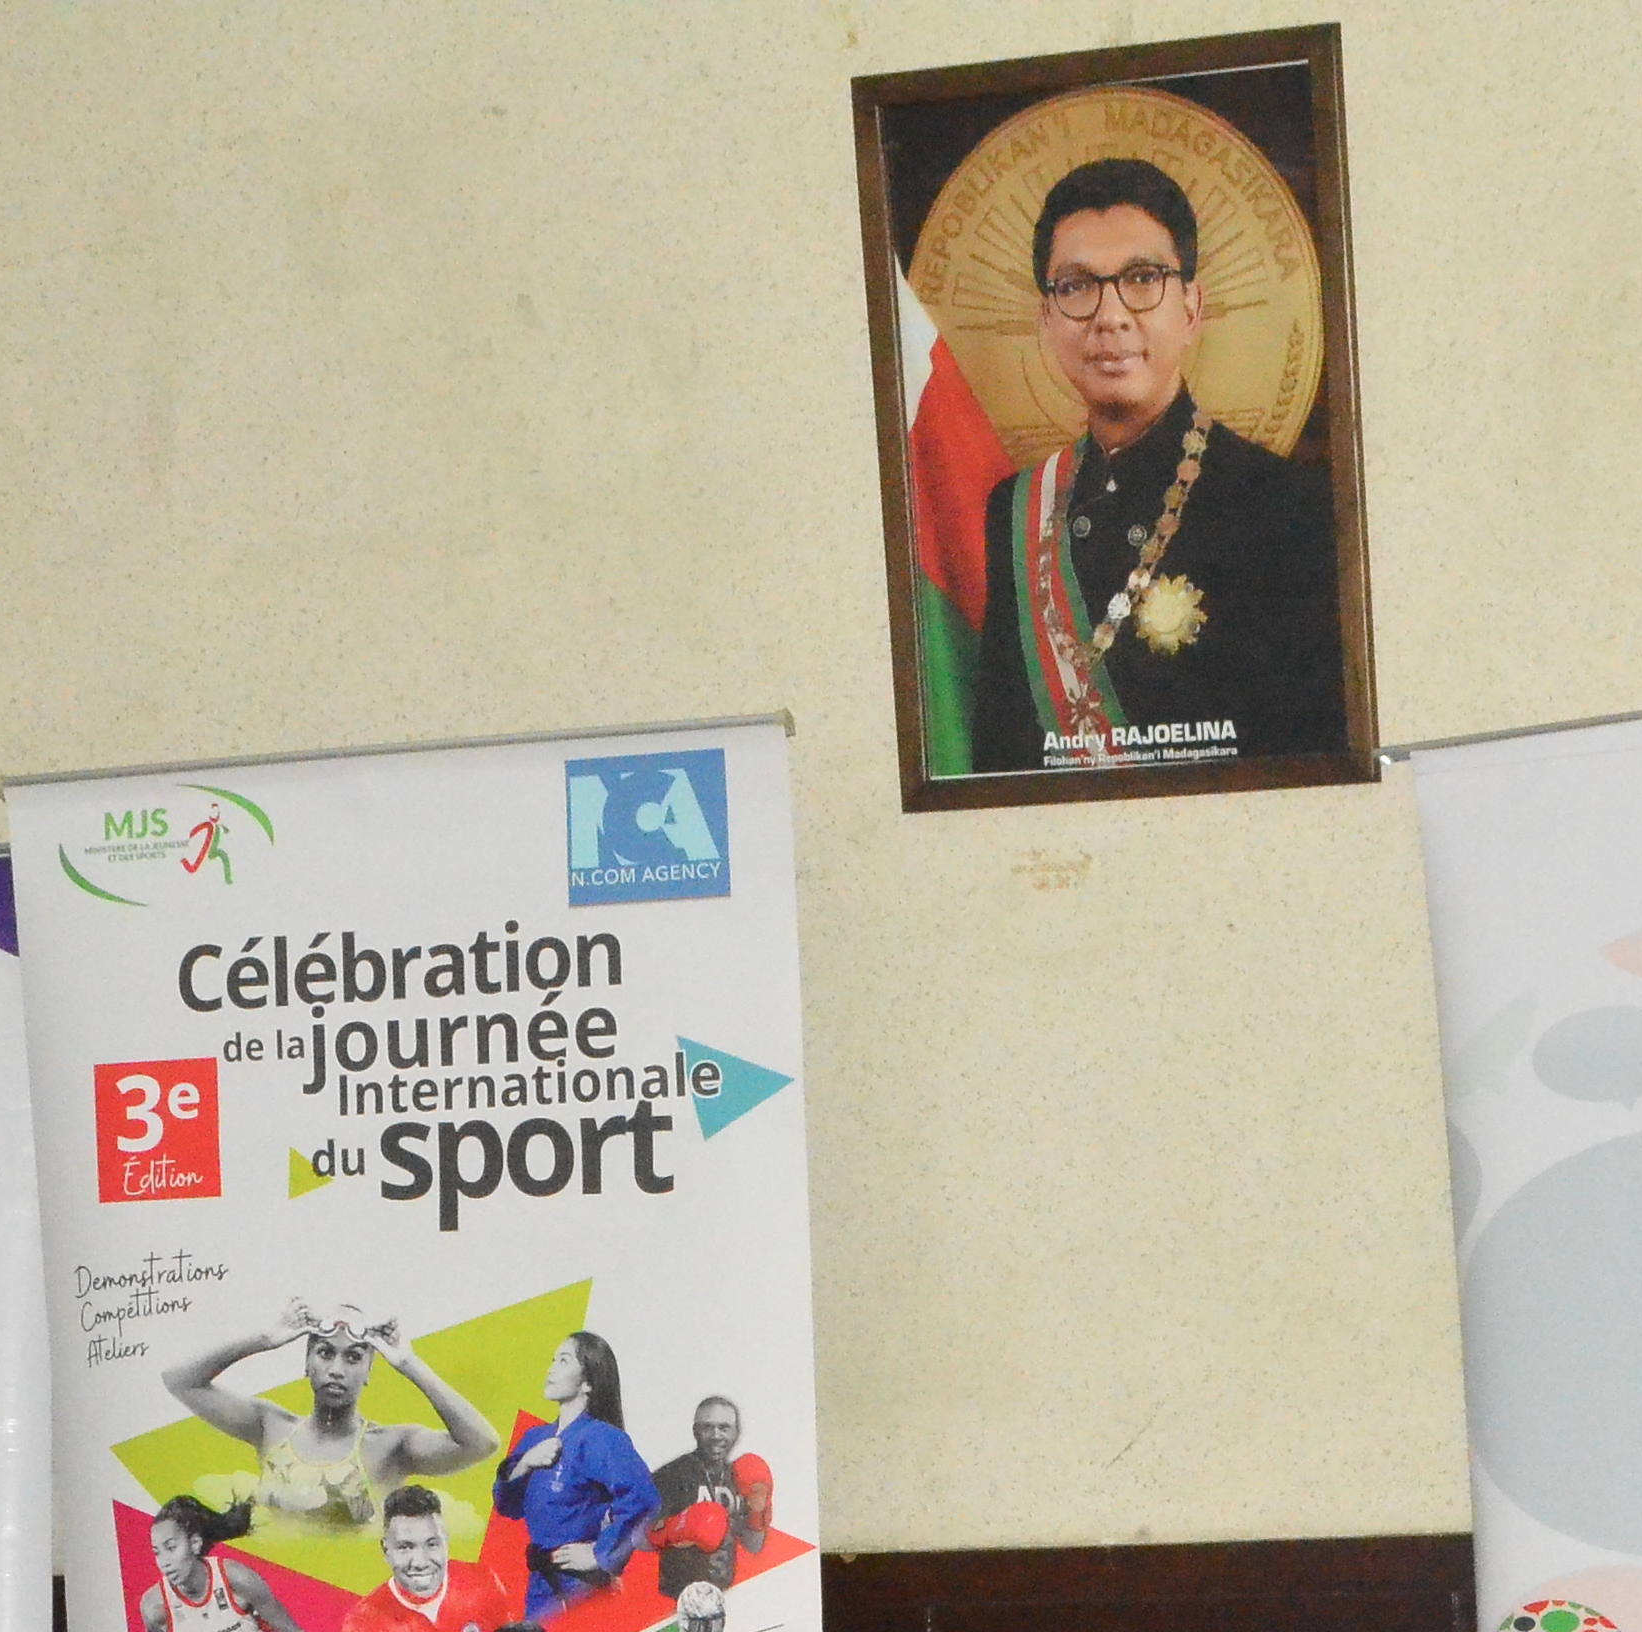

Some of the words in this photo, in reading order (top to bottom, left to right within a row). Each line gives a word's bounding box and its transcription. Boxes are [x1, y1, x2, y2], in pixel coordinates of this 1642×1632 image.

[1043, 731, 1106, 751] Andry
[1112, 720, 1237, 747] RAJOELINA
[104, 807, 169, 841] MJS
[572, 868, 636, 888] N.COM
[642, 861, 722, 883] AGENCY
[178, 919, 623, 1014] Célébration
[223, 1031, 264, 1063] de
[276, 1029, 305, 1060] la
[302, 990, 618, 1096] journée
[116, 1072, 202, 1154] 3e
[338, 1051, 722, 1117] Internationale
[312, 1138, 365, 1178] du
[379, 1100, 675, 1233] sport
[74, 1248, 230, 1299] Demonstrations
[87, 1334, 150, 1369] Ateliers
